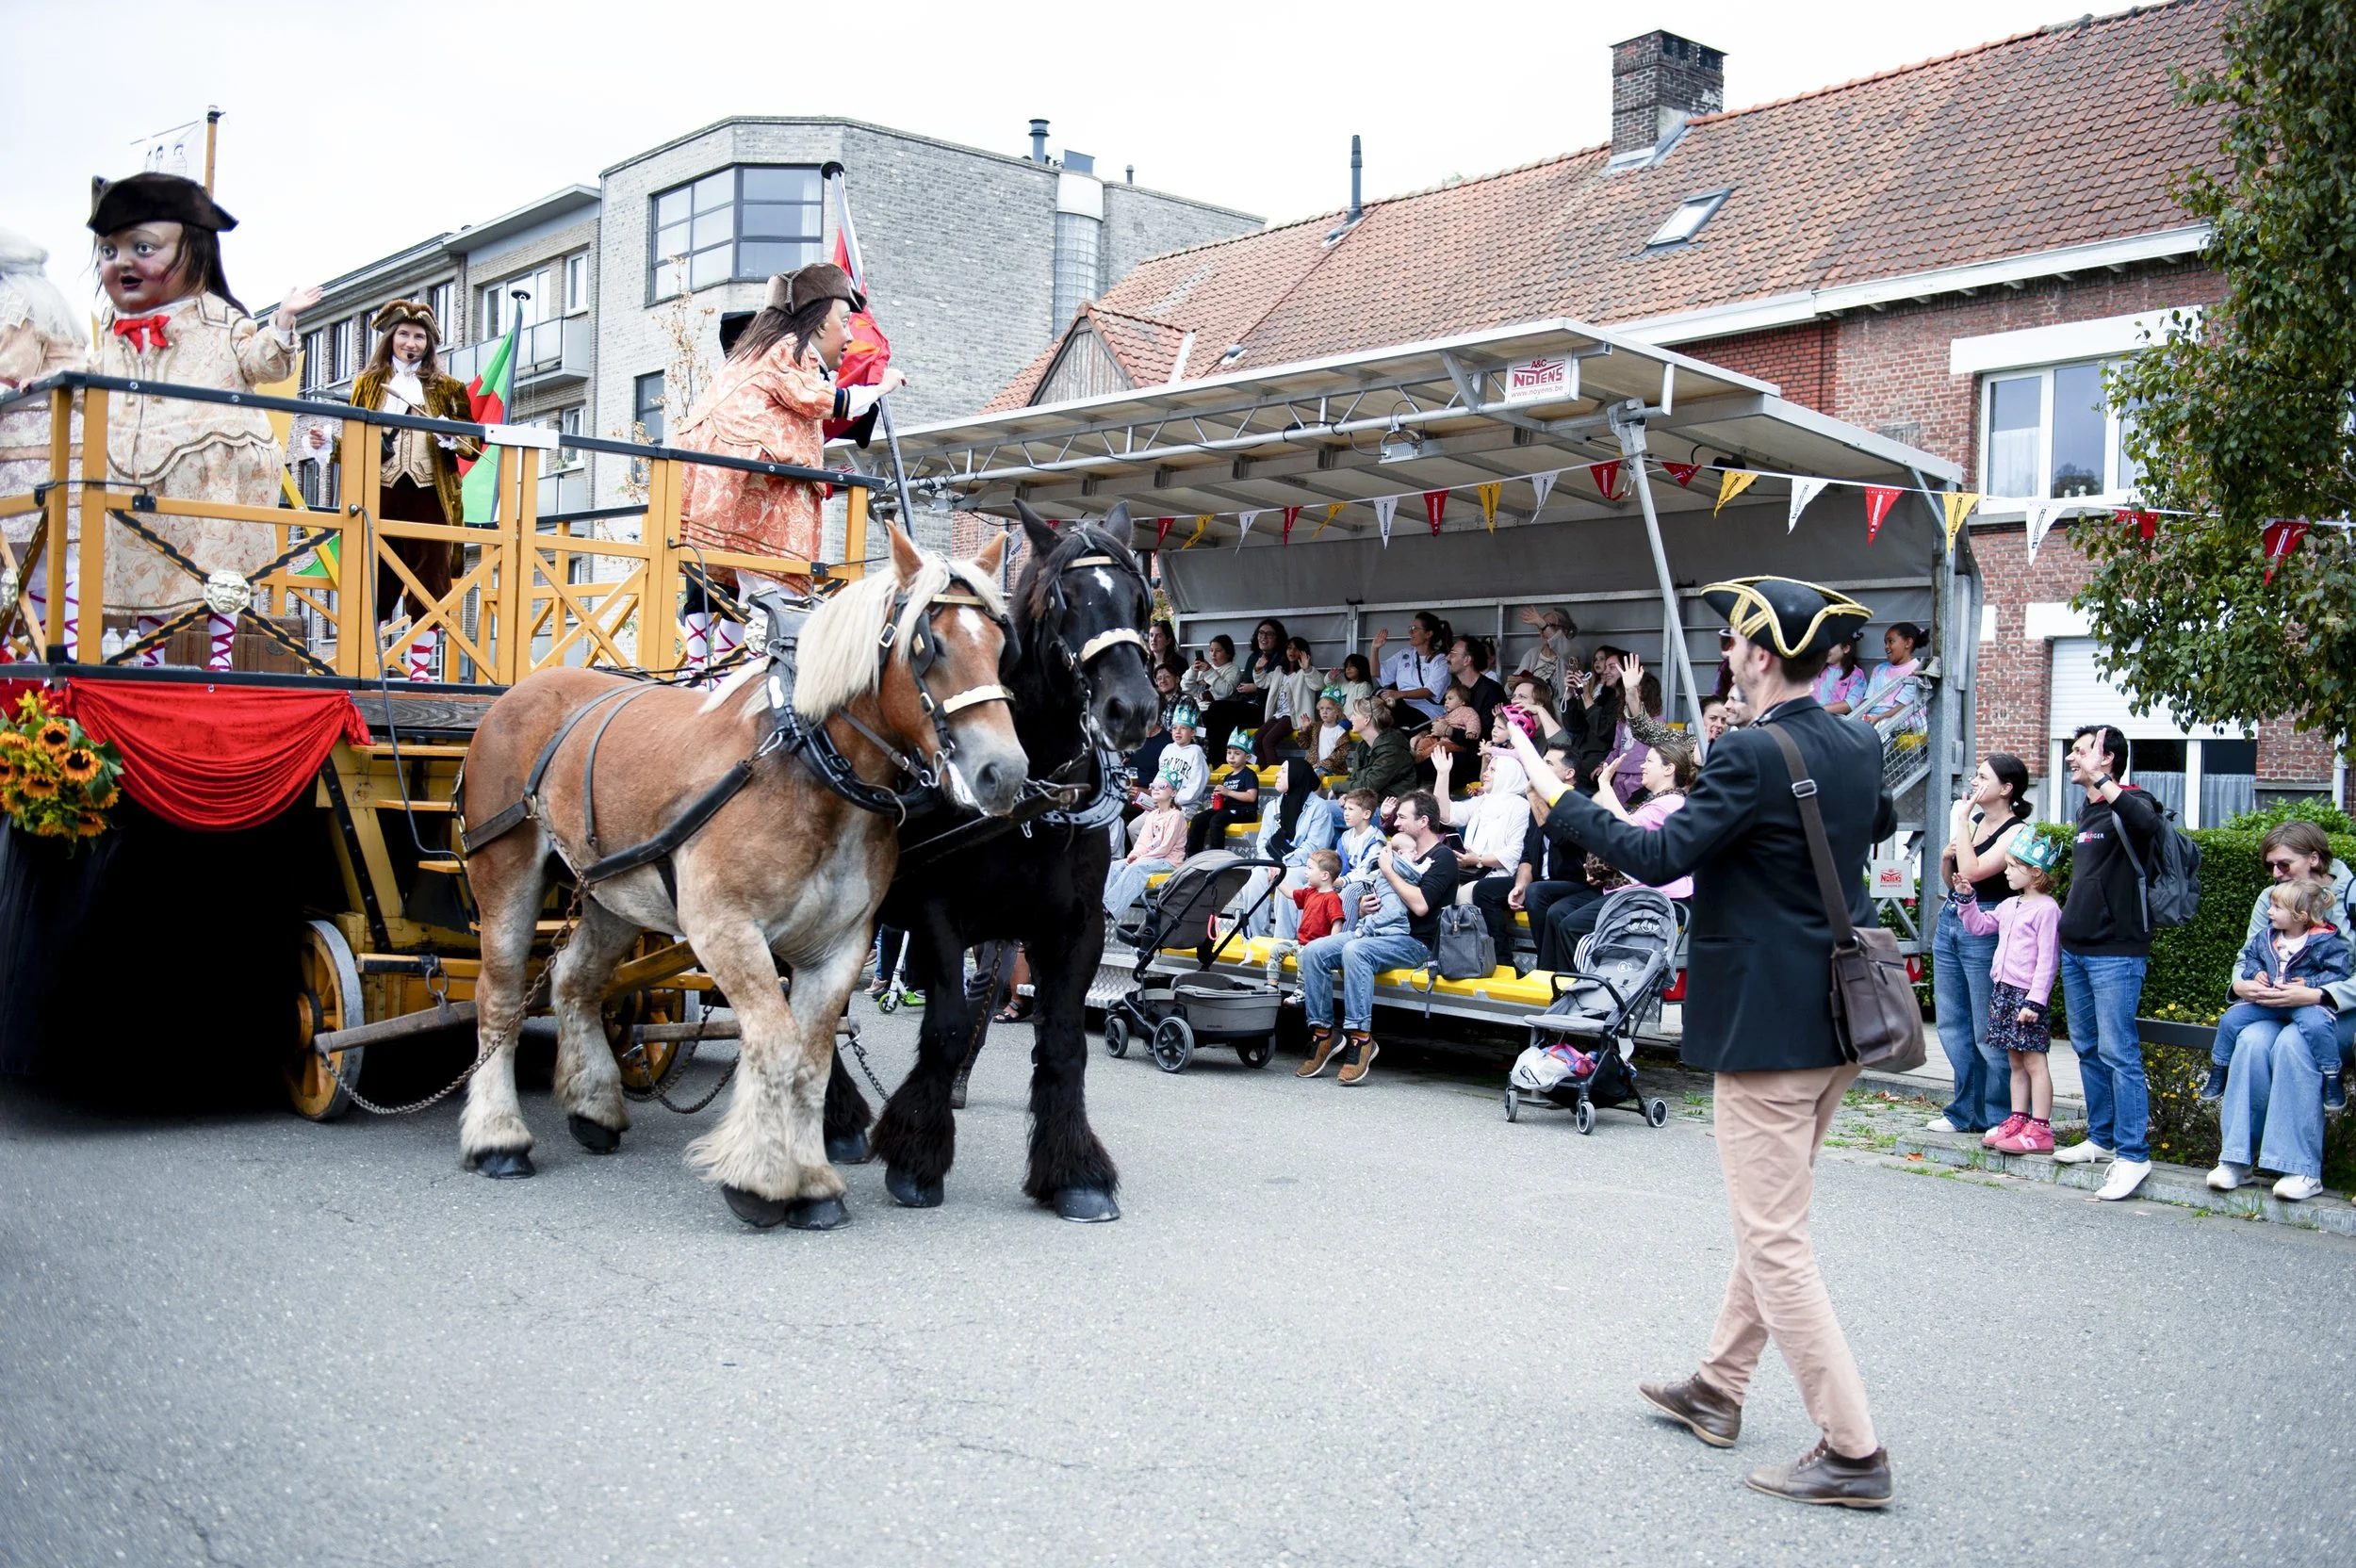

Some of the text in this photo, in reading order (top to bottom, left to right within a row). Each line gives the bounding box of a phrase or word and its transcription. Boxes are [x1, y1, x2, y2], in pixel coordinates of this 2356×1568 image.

[1530, 359, 1547, 369] A&C
[1513, 363, 1563, 387] NOYENS
[1511, 384, 1563, 398] www.noyens.be
